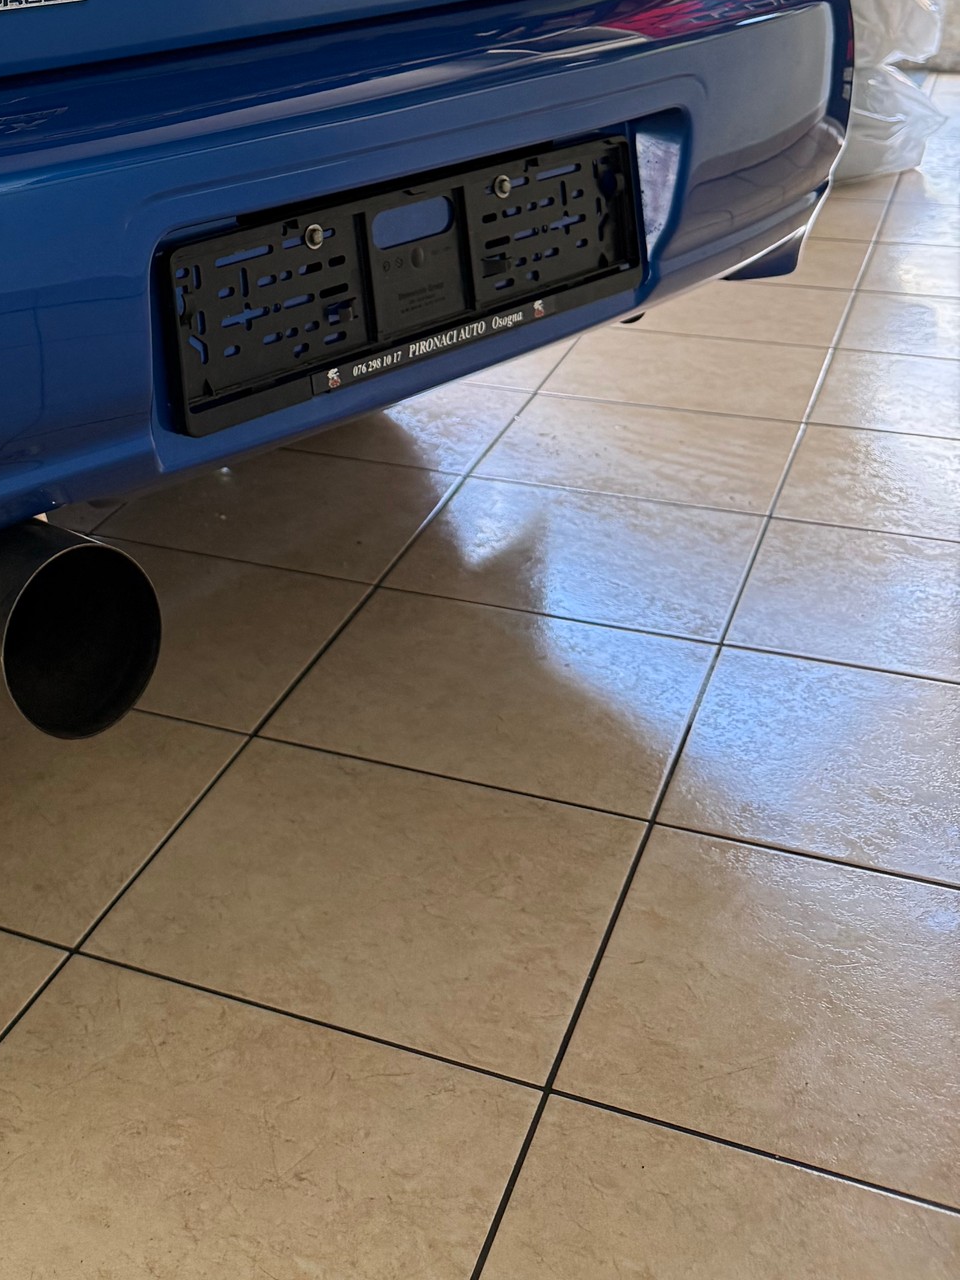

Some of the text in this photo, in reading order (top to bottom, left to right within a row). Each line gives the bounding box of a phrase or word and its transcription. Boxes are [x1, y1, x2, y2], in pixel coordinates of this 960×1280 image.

[352, 311, 523, 377] 076 298 10 17 PIRONACI AUTO Osogna
